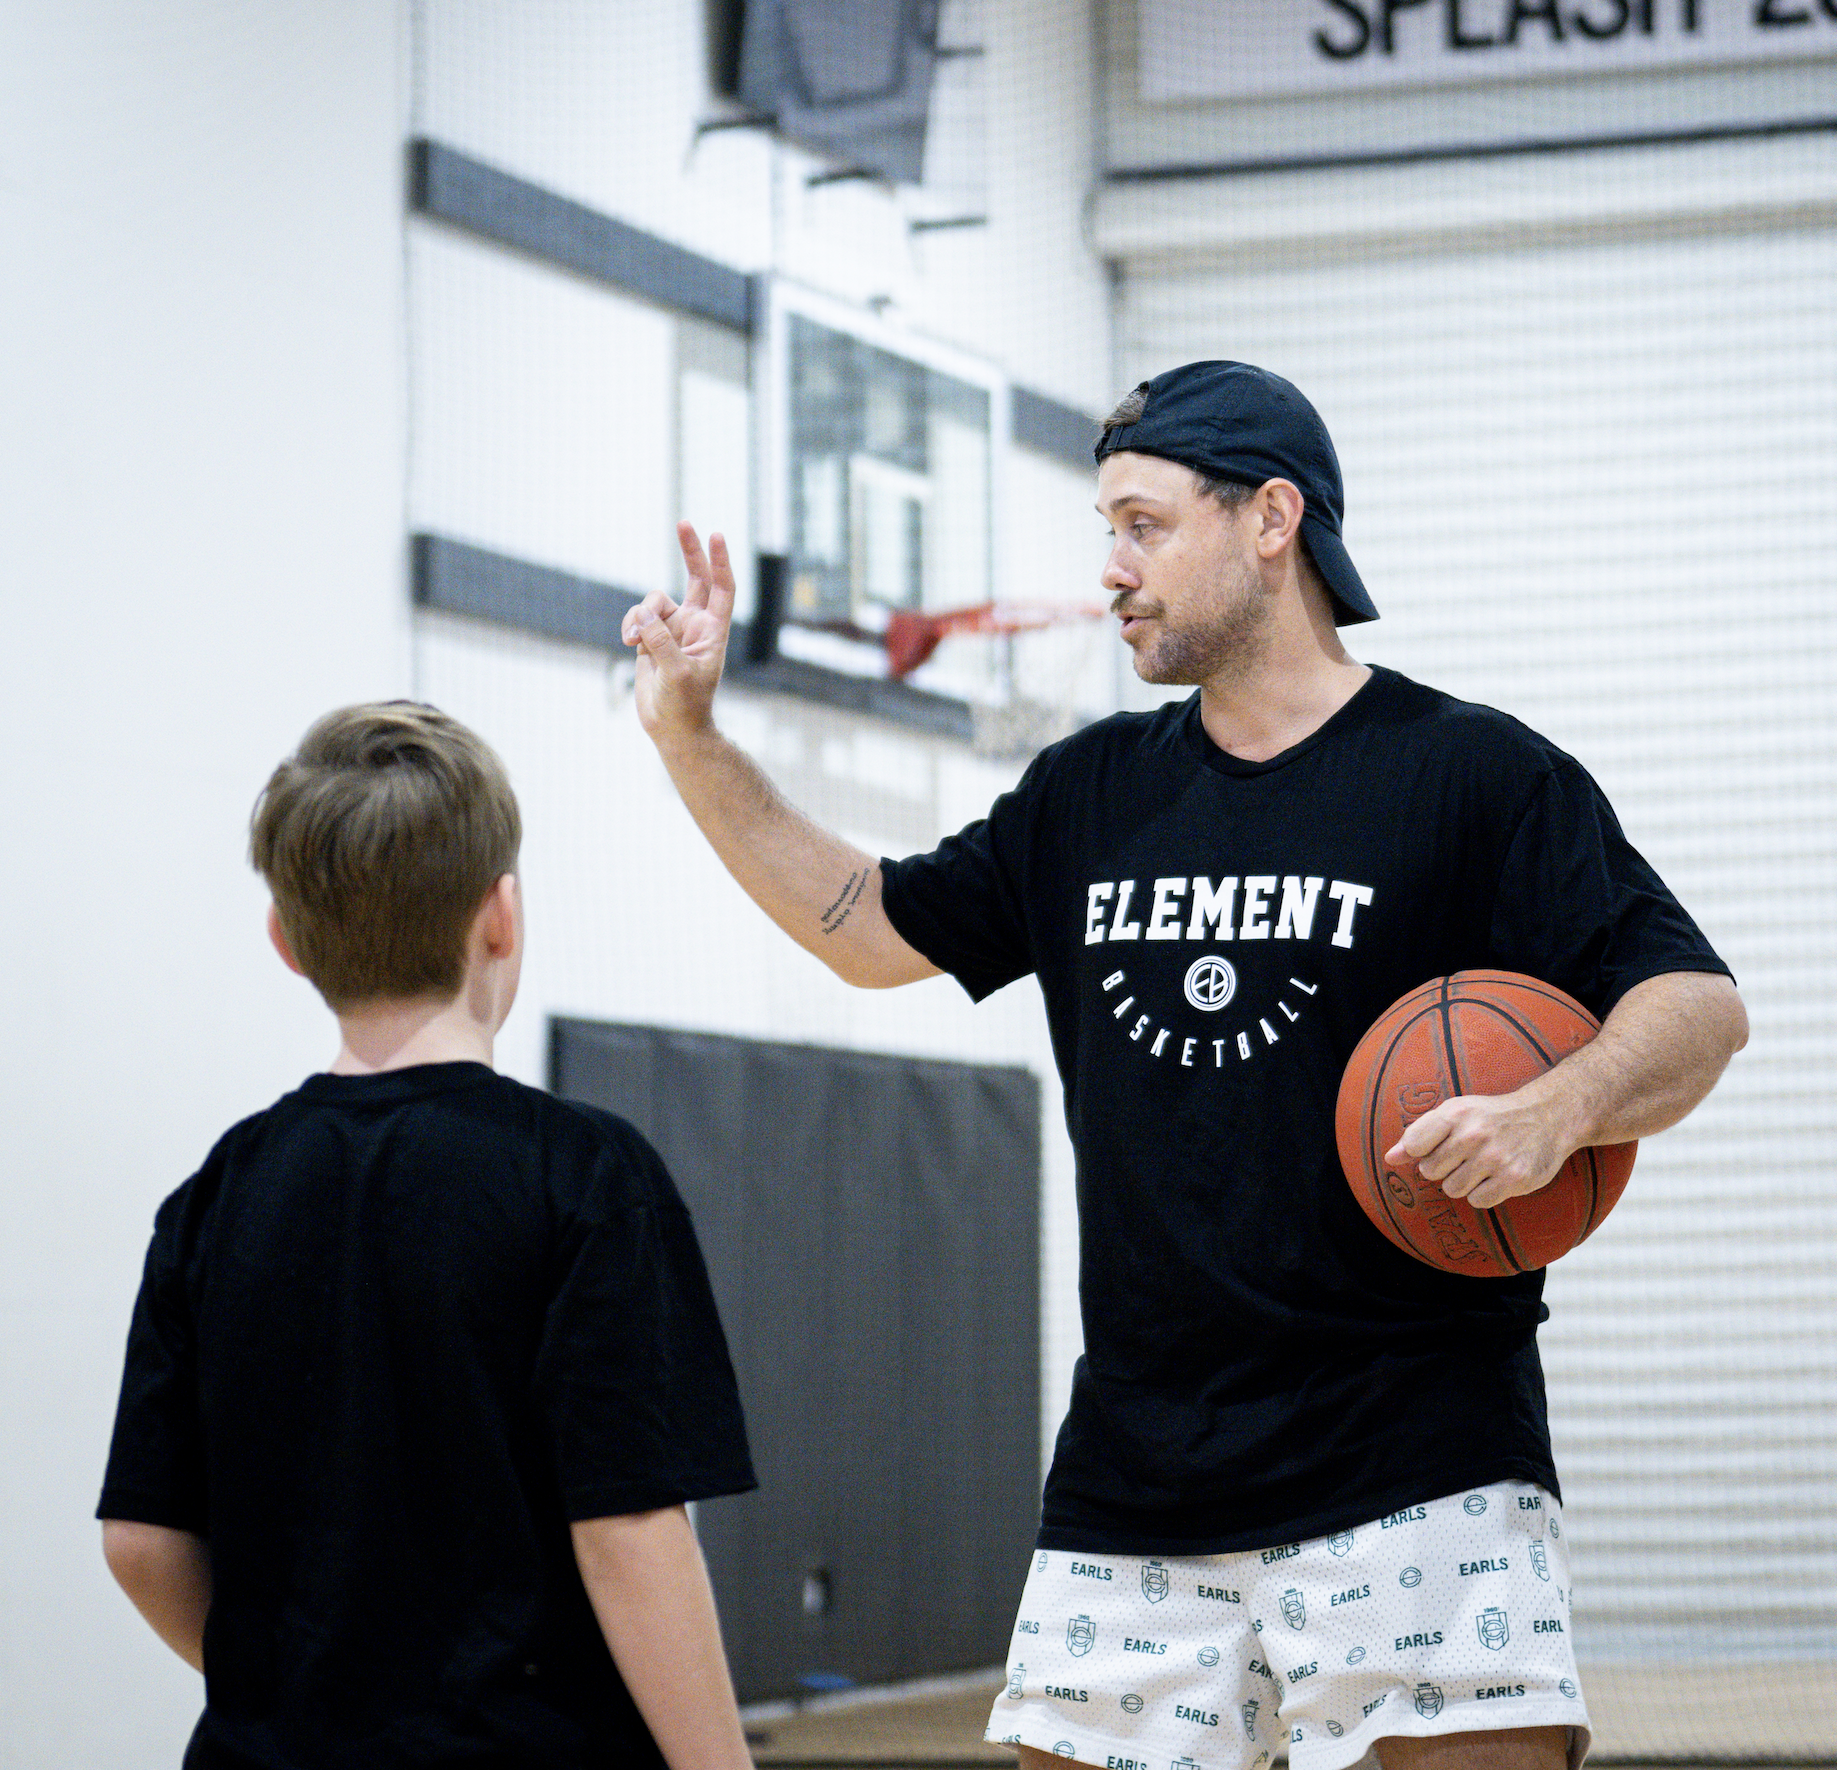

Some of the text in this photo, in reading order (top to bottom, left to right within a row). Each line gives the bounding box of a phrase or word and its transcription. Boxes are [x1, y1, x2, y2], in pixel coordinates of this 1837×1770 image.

[1084, 875, 1374, 949] ELEMENT
[1102, 969, 1318, 1068] BASKETBALL
[1518, 1496, 1542, 1510] EAR
[1380, 1506, 1427, 1529] EARLS
[1260, 1543, 1301, 1565] EARLS
[1070, 1561, 1113, 1581] EARLS
[1459, 1557, 1509, 1577] EARLS
[1197, 1584, 1241, 1604] EARLS
[1331, 1584, 1371, 1607] EARLS
[1018, 1621, 1040, 1635] EARLS
[1533, 1619, 1564, 1634] EARL
[1123, 1637, 1167, 1656] EARLS
[1395, 1631, 1444, 1651] EARLS
[1286, 1661, 1319, 1684] EARLS
[1045, 1685, 1089, 1703] EARLS
[1475, 1684, 1526, 1701] EARLS
[1175, 1704, 1220, 1728] EARLS
